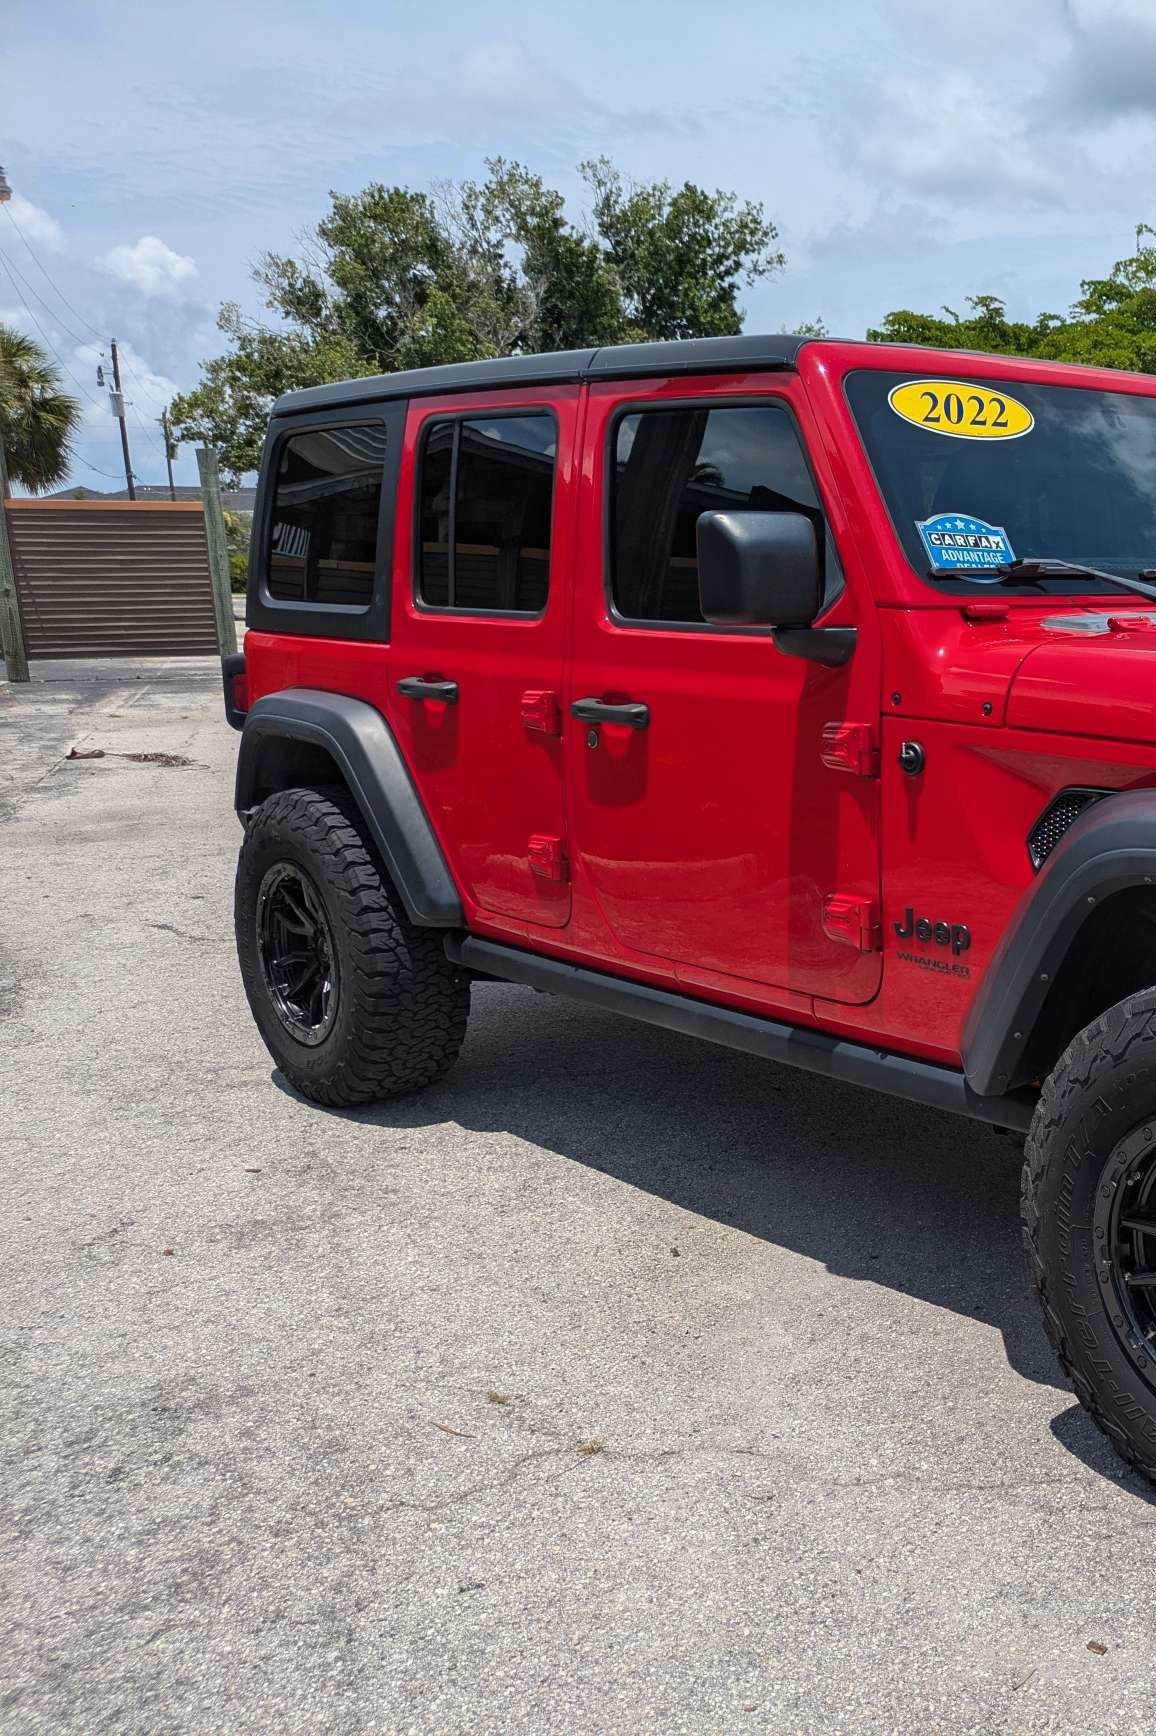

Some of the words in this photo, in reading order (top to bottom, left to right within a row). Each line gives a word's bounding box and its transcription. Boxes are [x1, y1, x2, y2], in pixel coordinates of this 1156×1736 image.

[919, 391, 1009, 428] 2022
[928, 532, 1005, 550] CARFAX
[941, 549, 1005, 564] ADVANTAGE
[894, 907, 971, 956] Jeep
[896, 951, 970, 977] WRANGLER
